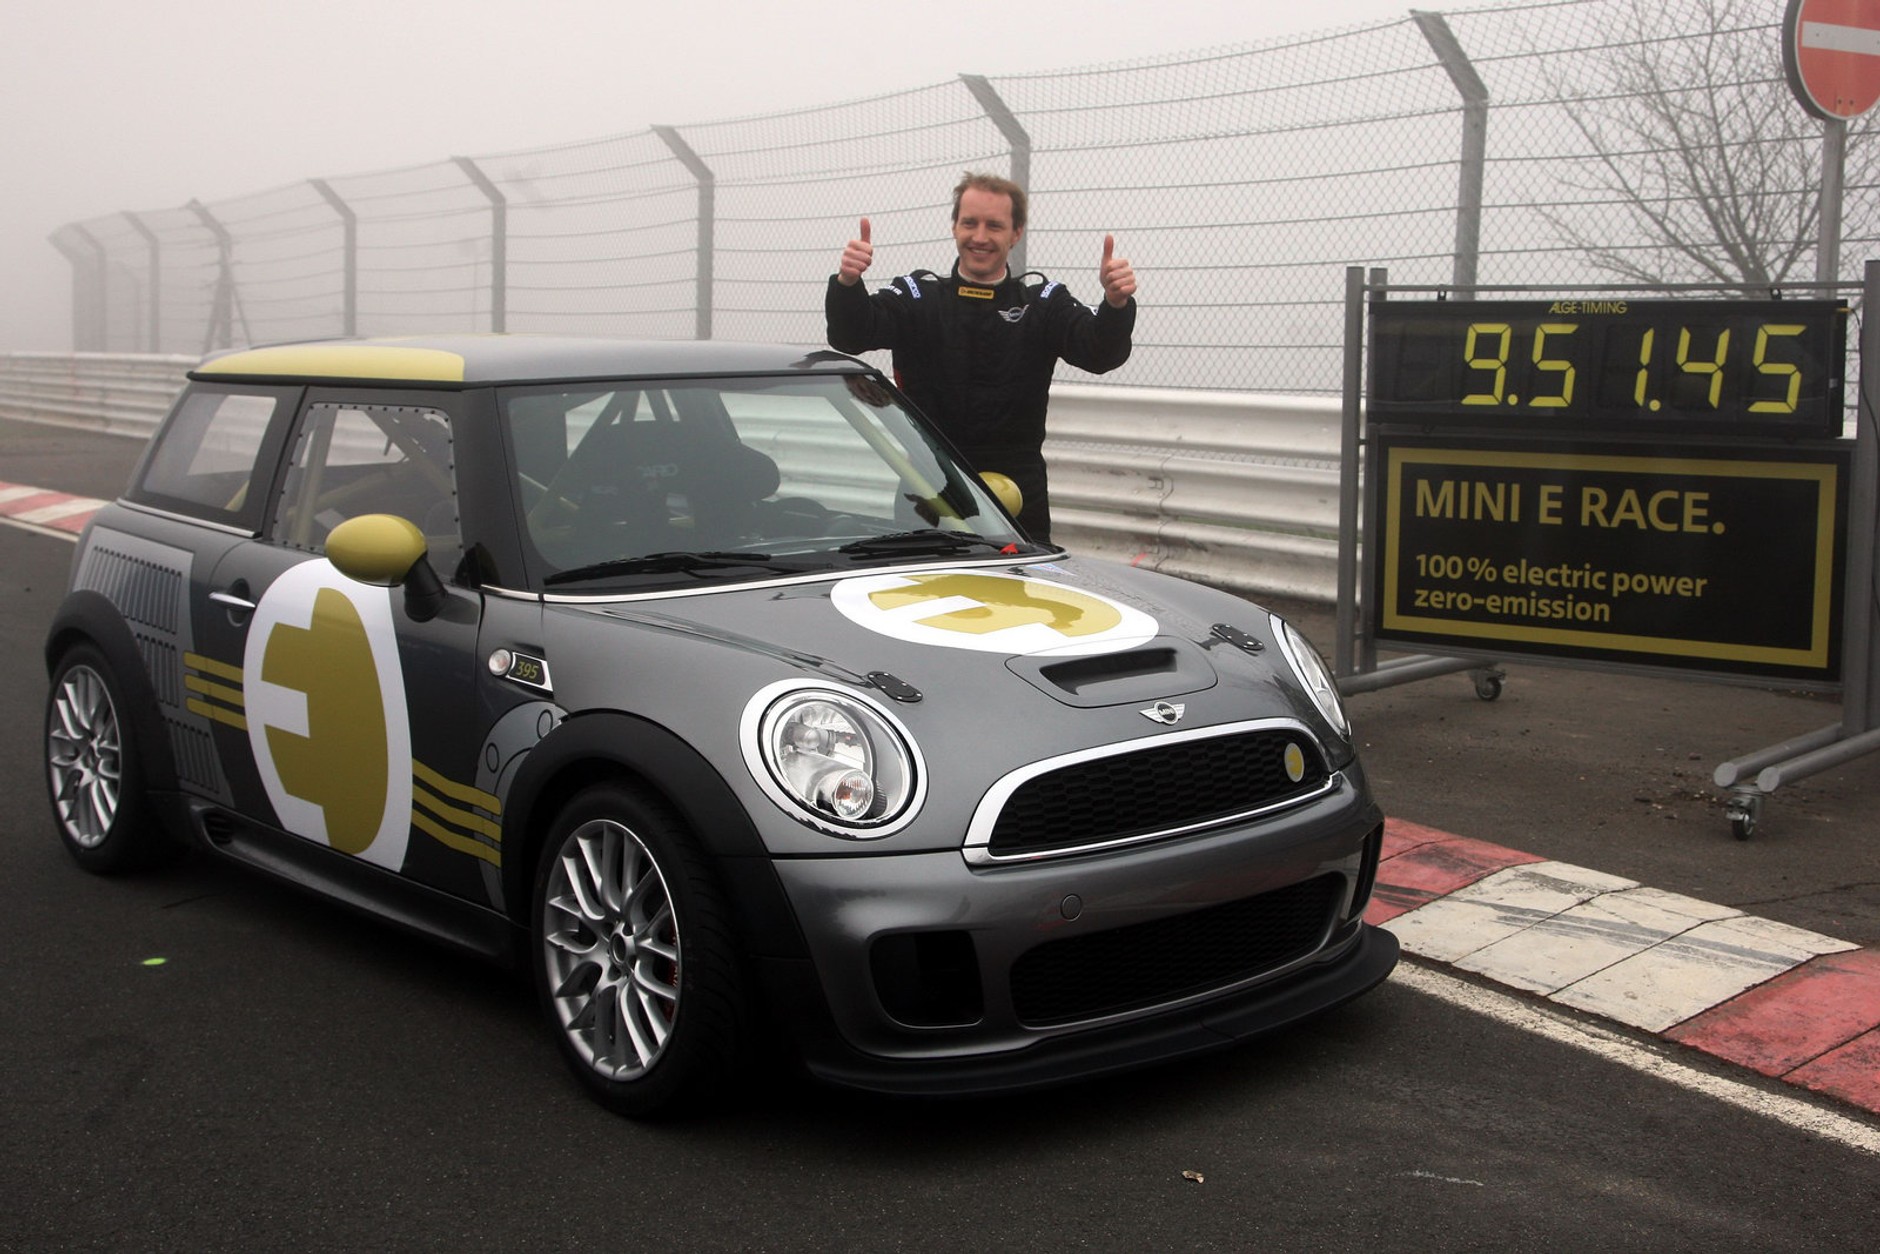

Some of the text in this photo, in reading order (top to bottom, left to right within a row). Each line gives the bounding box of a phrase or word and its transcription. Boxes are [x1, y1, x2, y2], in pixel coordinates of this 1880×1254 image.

[1415, 479, 1726, 536] MINI E RACE.
[1502, 558, 1607, 591] electric
[1611, 571, 1709, 598] power
[1413, 588, 1612, 623] zero-emission
[516, 661, 540, 680] 395
